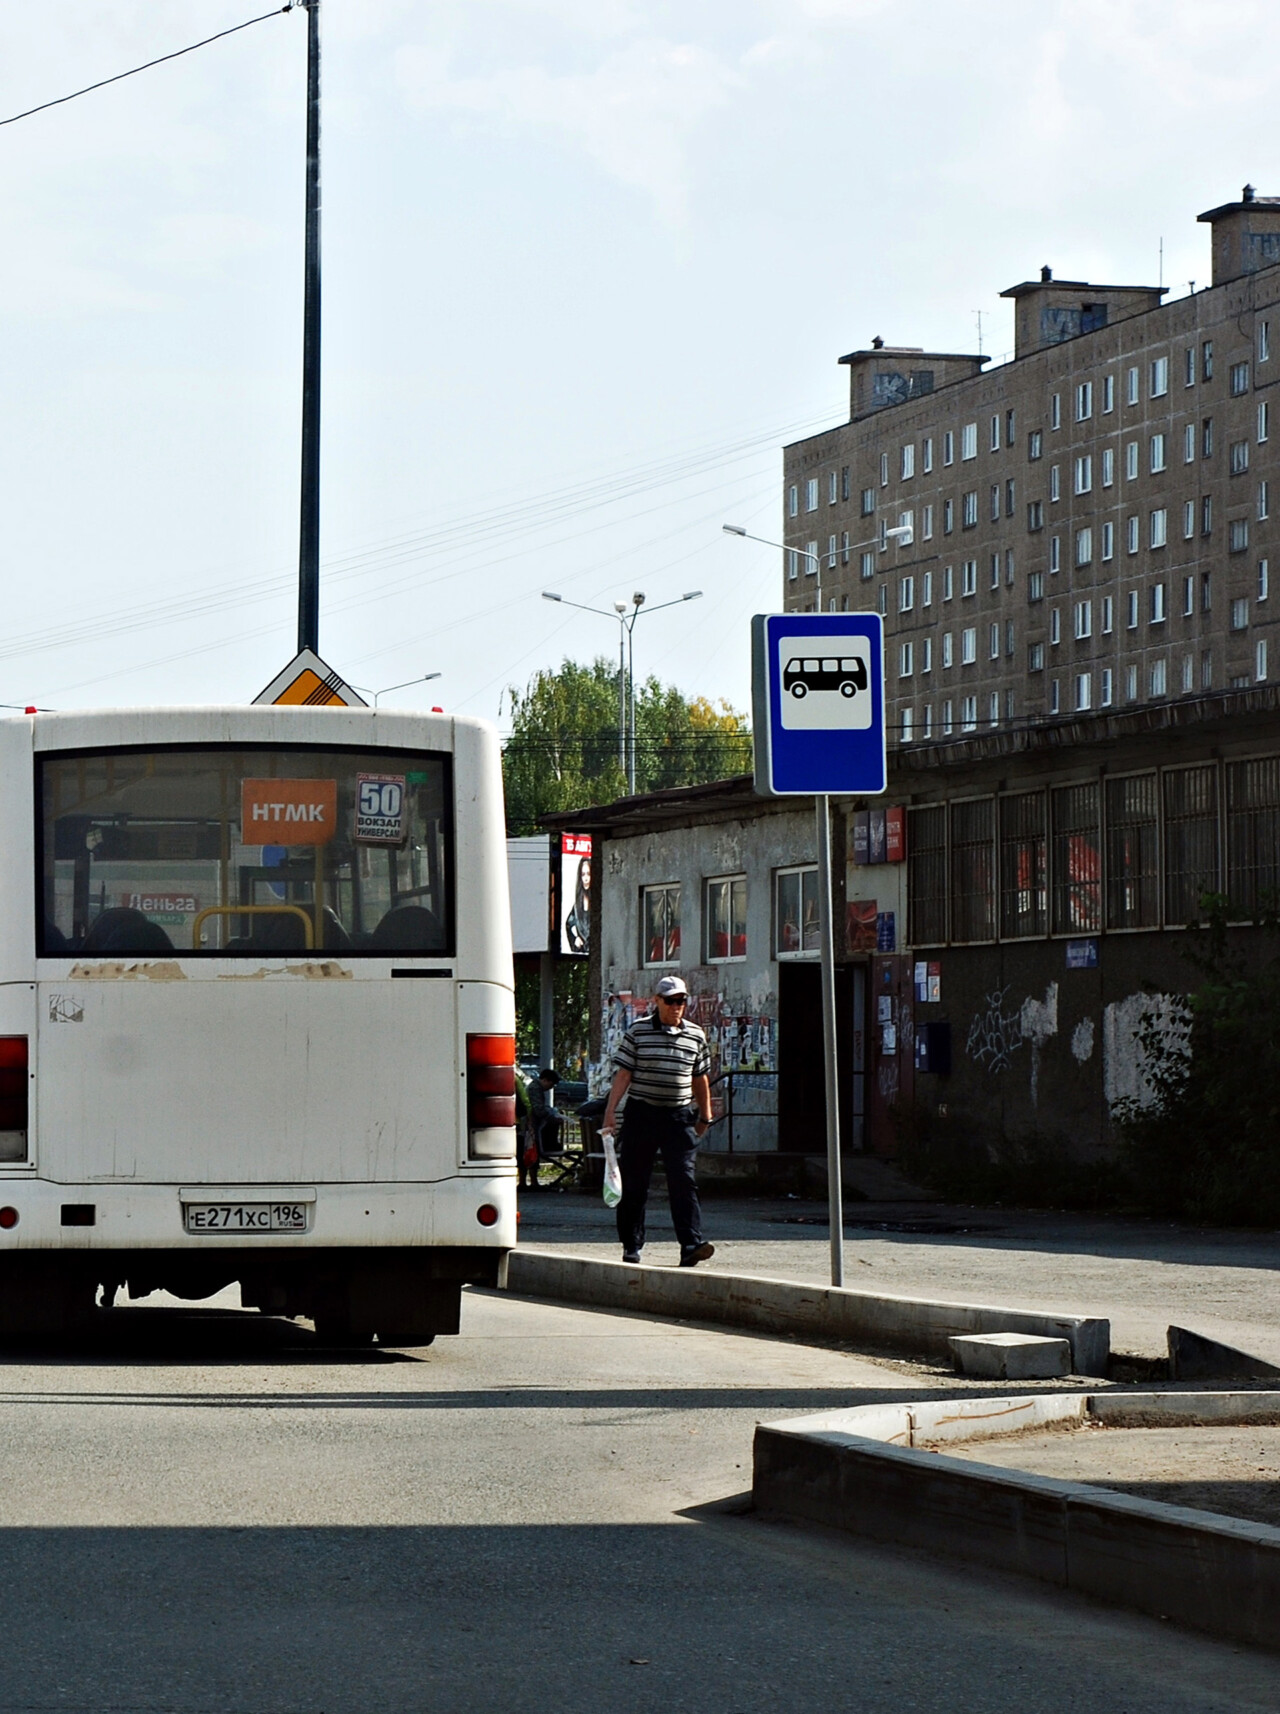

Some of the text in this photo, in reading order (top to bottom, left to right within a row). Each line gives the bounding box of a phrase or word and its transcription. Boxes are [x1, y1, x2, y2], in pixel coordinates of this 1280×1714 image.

[360, 782, 401, 817] 50
[252, 803, 325, 822] НТМК
[358, 816, 401, 828] ВОКЗАЛ
[356, 827, 400, 839] УНИВЕРСАМ
[273, 1206, 302, 1220] 196
